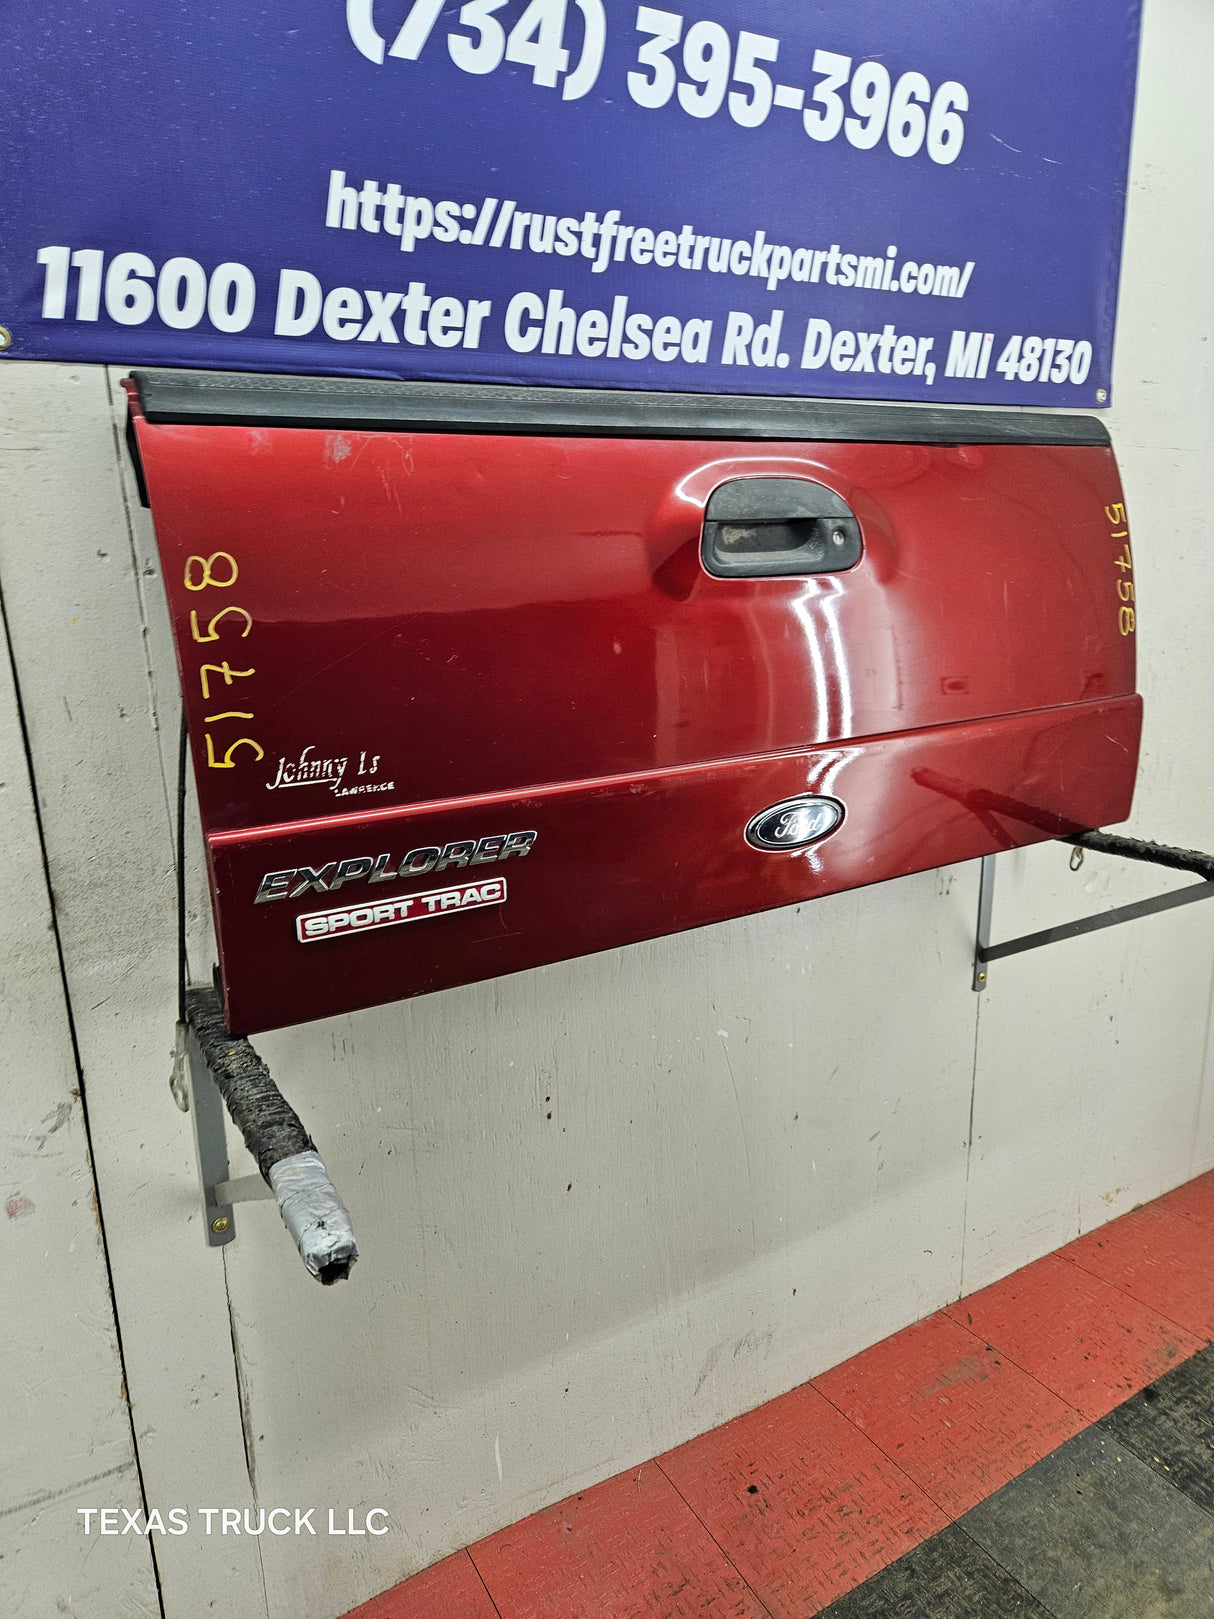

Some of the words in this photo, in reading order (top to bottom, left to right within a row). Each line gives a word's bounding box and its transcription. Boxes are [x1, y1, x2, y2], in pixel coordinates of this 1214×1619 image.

[626, 5, 970, 165] 395-3966
[325, 169, 975, 299] https://rustfreetruckpartsmi.com/
[37, 246, 256, 333] 11600
[274, 268, 492, 349] Dexter
[504, 289, 713, 364] Chelsea
[721, 310, 790, 369] Rd.
[800, 318, 936, 386] Dexter,
[944, 330, 995, 379] MI
[996, 335, 1093, 386] 48130
[1104, 502, 1136, 636] 51758
[183, 551, 265, 770] 51758
[253, 830, 538, 905] EXPLORER
[773, 811, 822, 839] Fod
[304, 900, 414, 937] SPORT
[421, 882, 502, 912] TRAC
